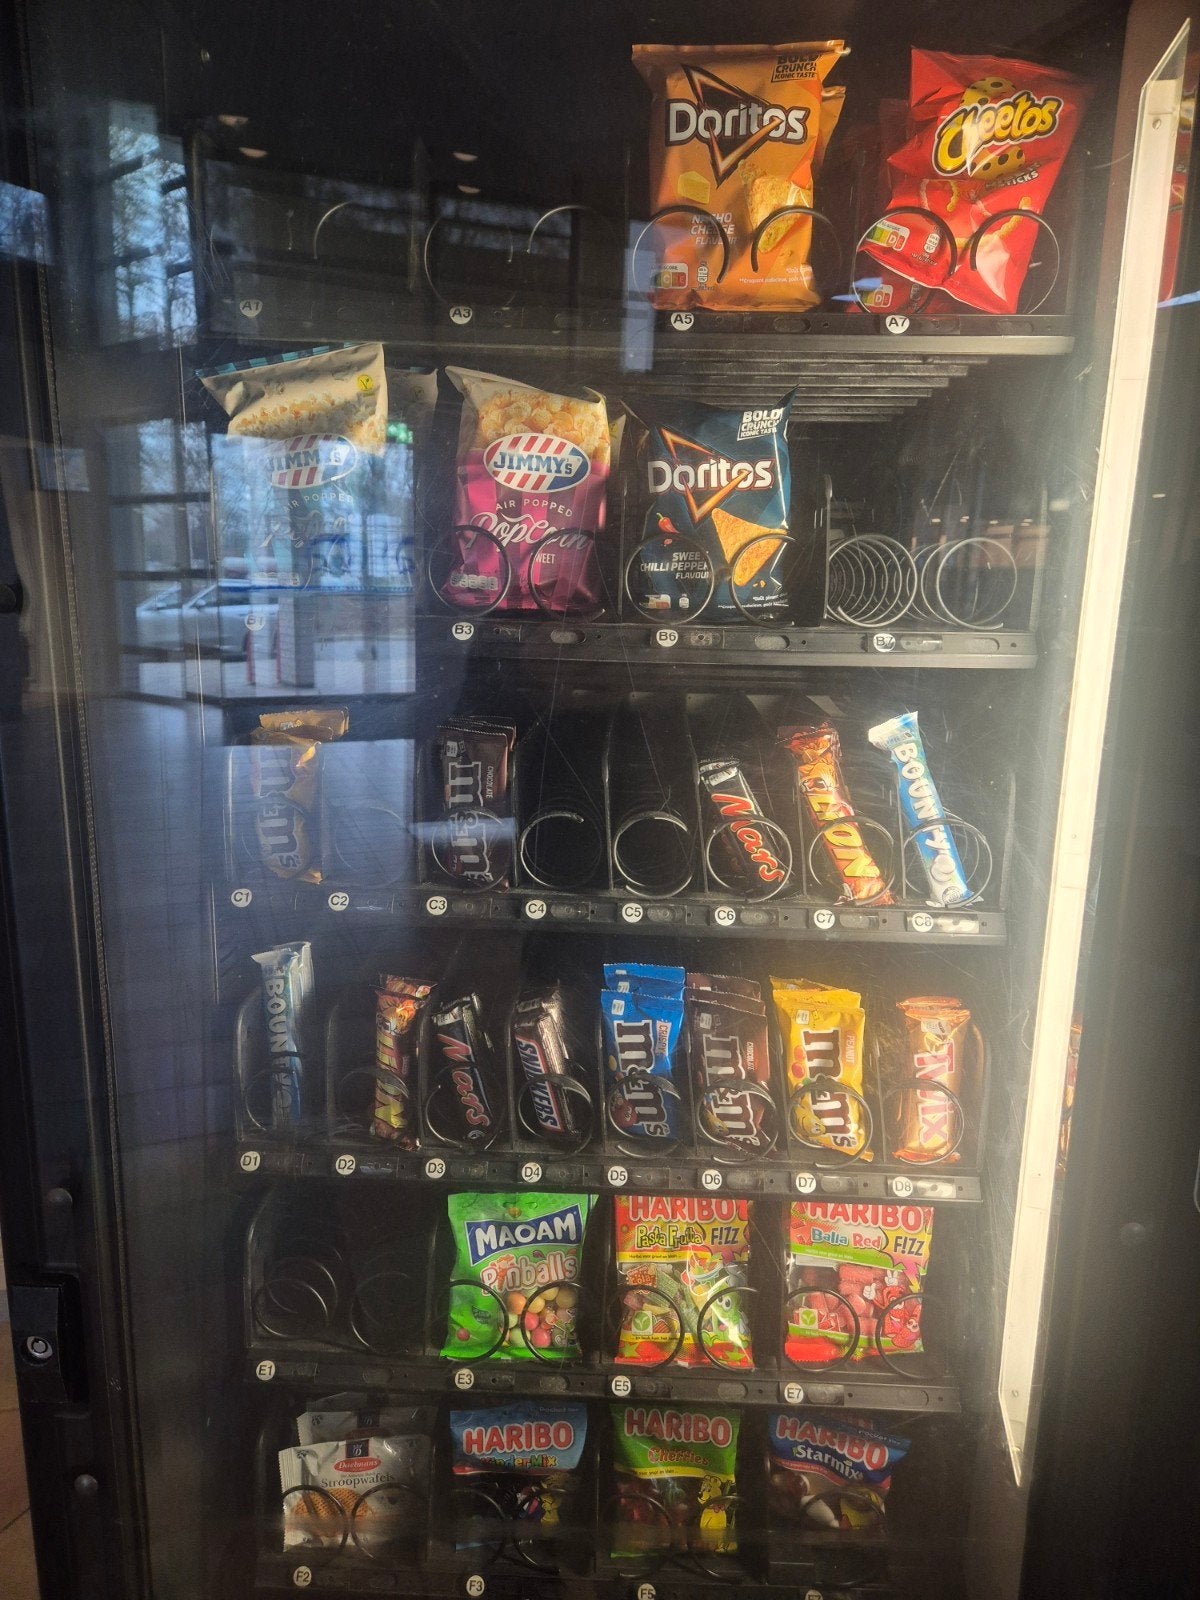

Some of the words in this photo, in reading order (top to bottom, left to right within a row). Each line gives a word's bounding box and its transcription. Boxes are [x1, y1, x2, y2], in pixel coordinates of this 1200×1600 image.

[775, 62, 817, 74] CRUNCH
[796, 71, 816, 79] TASTE
[667, 101, 808, 143] Doritos
[932, 91, 1062, 176] Cheetos
[241, 301, 262, 311] A1
[452, 307, 472, 318] A3
[673, 313, 693, 325] A5
[888, 316, 908, 328] A7
[742, 407, 784, 423] BOLD
[647, 458, 774, 494] Doritos
[496, 500, 516, 511] AIR
[523, 499, 574, 518] POPPED
[531, 553, 556, 564] WEET
[672, 551, 704, 562] SWEE
[675, 571, 711, 580] FLAVOU
[454, 624, 473, 636] B3
[658, 631, 678, 642] B6
[875, 636, 894, 647] B7
[232, 890, 250, 903] C1
[330, 894, 348, 907] C2
[428, 899, 446, 911] C3
[527, 903, 545, 915] C4
[624, 906, 642, 918] C5
[717, 910, 734, 922] C6
[816, 912, 833, 924] C7
[846, 1034, 856, 1065] PEANUT
[242, 1155, 259, 1167] D1
[337, 1159, 355, 1171] D2
[427, 1162, 445, 1174] D3
[524, 1167, 541, 1179] D4
[610, 1170, 627, 1182] D5
[704, 1174, 721, 1186] D6
[798, 1177, 815, 1189] D7
[895, 1181, 912, 1193] D8
[629, 1195, 736, 1222] HARIBO
[808, 1202, 923, 1233] HARIBO
[474, 1212, 577, 1257] MAOAM
[637, 1225, 667, 1249] Pasta
[668, 1224, 703, 1249] Frutta
[811, 1228, 848, 1246] Balla
[852, 1232, 882, 1250] Red
[258, 1364, 274, 1377] E1
[457, 1373, 473, 1385] E3
[787, 1387, 801, 1399] E7
[625, 1406, 732, 1448] HARIBO
[463, 1420, 574, 1454] HARIBO
[776, 1414, 890, 1471] HARIBO
[795, 1445, 859, 1480] Starmix
[321, 1473, 395, 1490] Stroopwafels
[295, 1571, 311, 1583] F2
[468, 1579, 484, 1592] F3
[640, 1587, 654, 1600] F5
